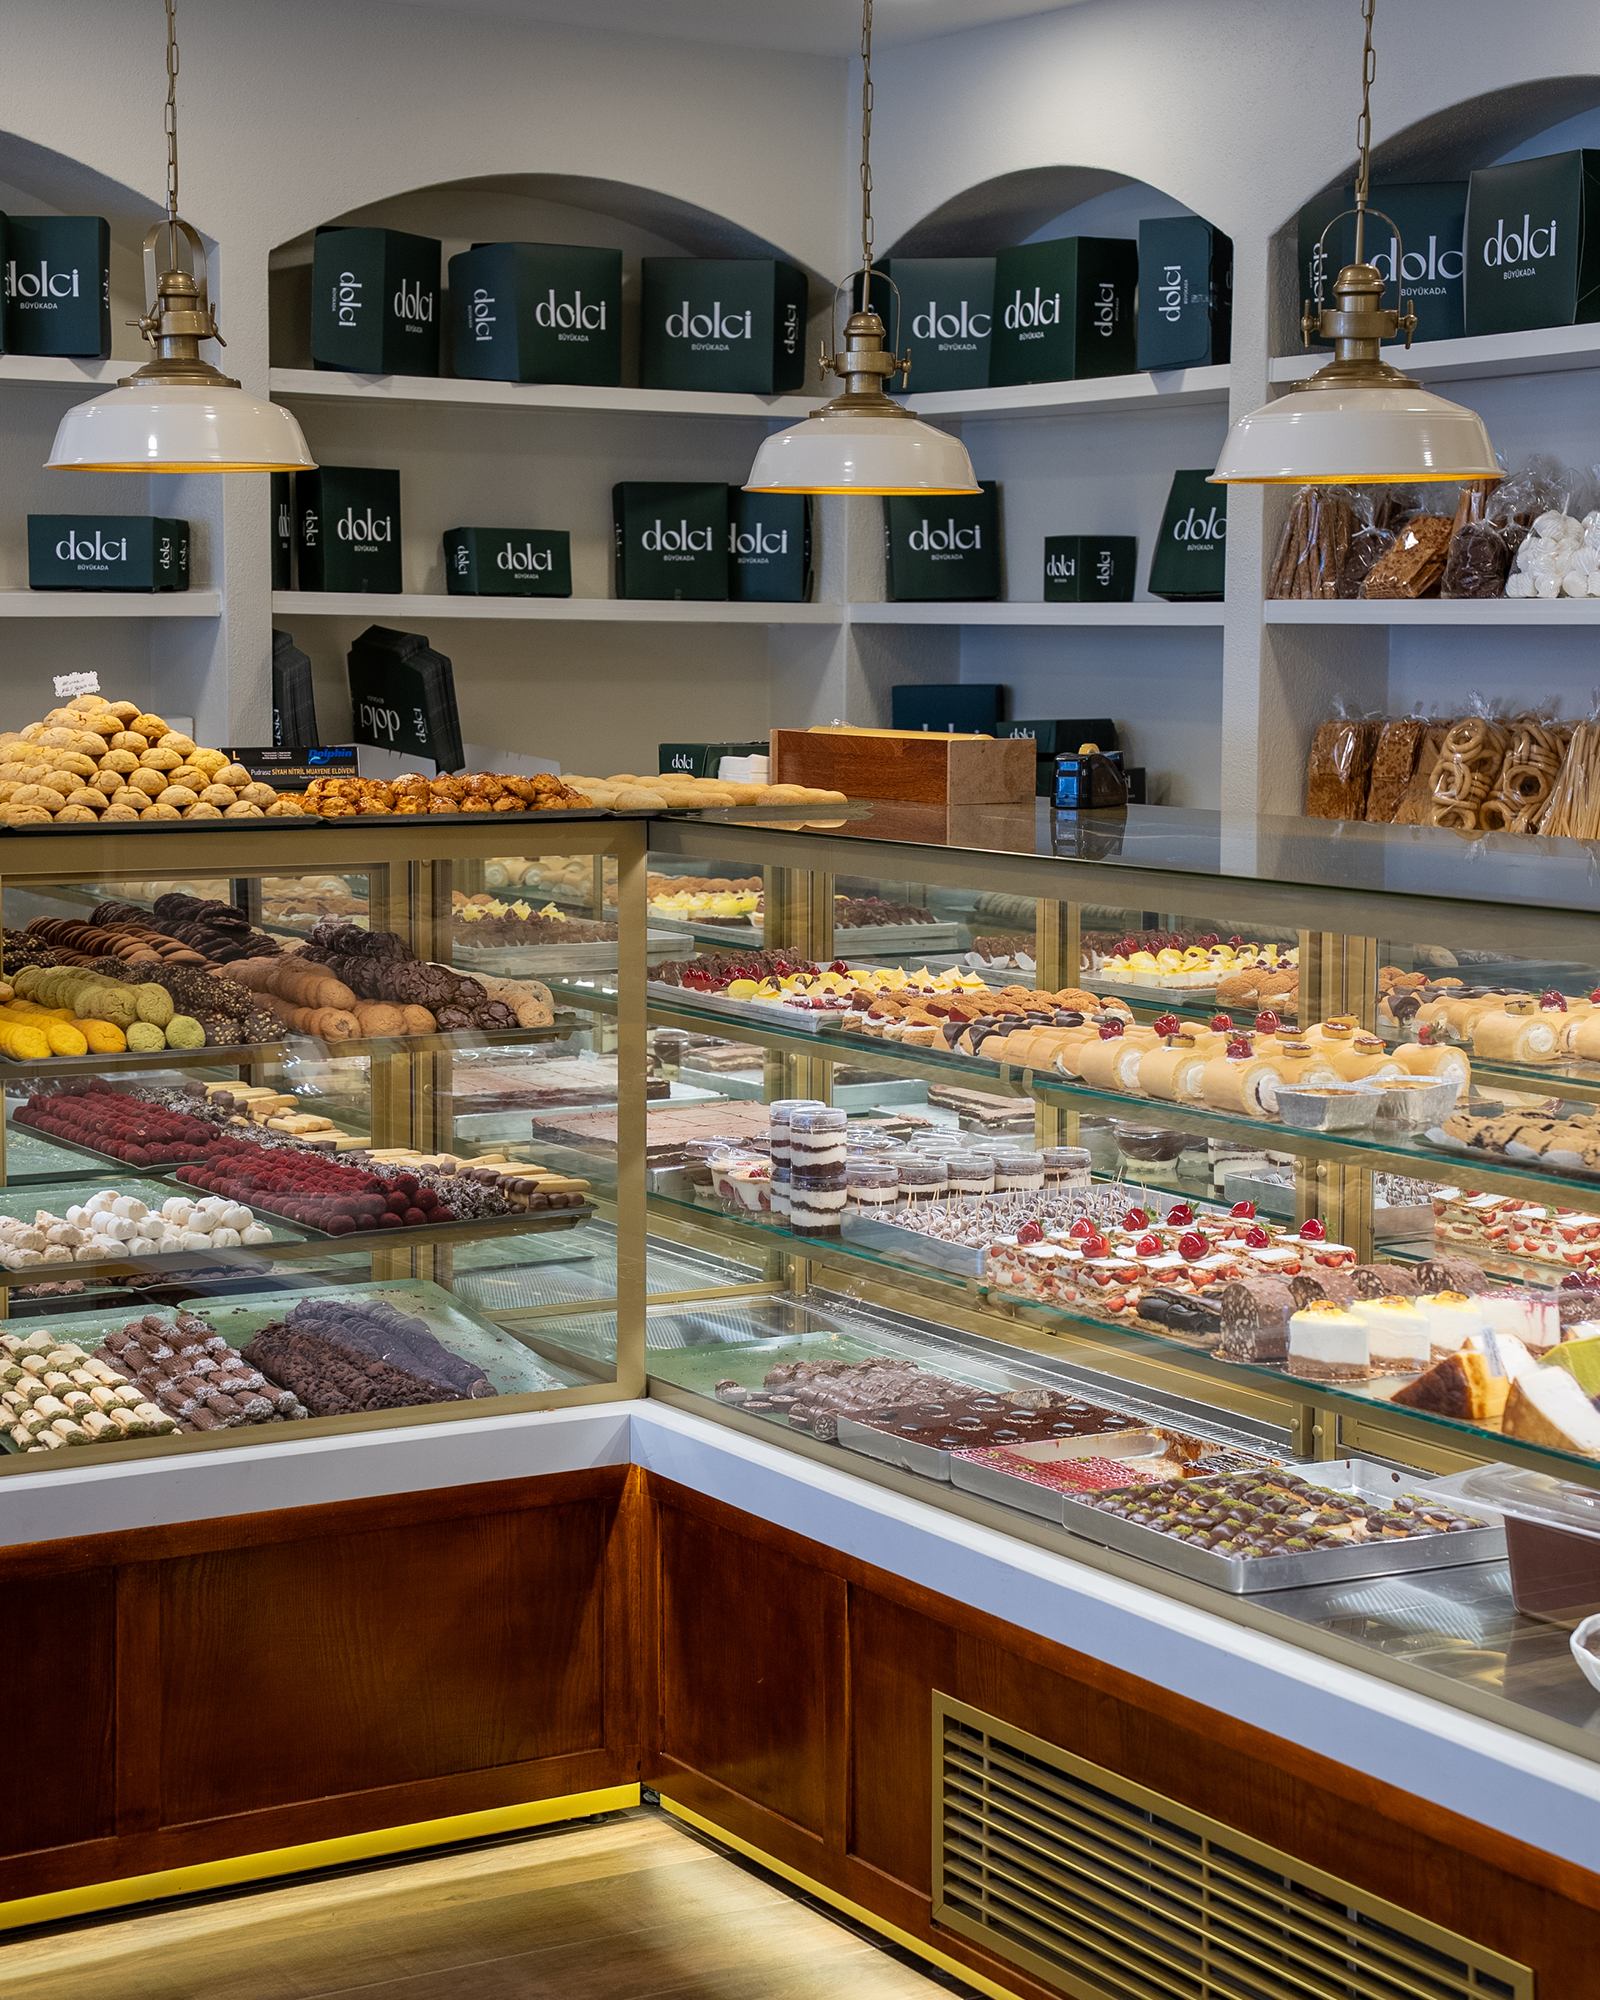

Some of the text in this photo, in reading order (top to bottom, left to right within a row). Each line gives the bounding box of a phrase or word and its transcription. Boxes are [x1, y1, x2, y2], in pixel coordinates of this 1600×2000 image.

[1483, 213, 1557, 267] dolci
[1503, 267, 1536, 280] BÜYÜKADA
[20, 302, 58, 310] BÜYÜKADA
[338, 271, 362, 327] dolci
[394, 278, 433, 322] dolci
[1004, 287, 1060, 329] dolci
[1158, 265, 1181, 322] dolci
[1400, 287, 1447, 297] BÜYÜKADA
[473, 288, 497, 341] dolci
[535, 289, 606, 330] dolci
[665, 301, 752, 339] dolci
[1094, 283, 1114, 337] dolci
[558, 333, 589, 342] BÜYÜKADA
[783, 304, 797, 354] dolci
[691, 343, 730, 351] BÜYÜKADA
[938, 343, 977, 351] BÜYÜKADA
[305, 509, 319, 546] dolci
[337, 507, 391, 542] dolci
[641, 519, 713, 551] dolci
[908, 518, 982, 551] dolci
[55, 530, 127, 561] dolci
[159, 537, 170, 569] dolci
[457, 545, 469, 575] dolci
[497, 542, 552, 571] dolci
[663, 554, 695, 562] BÜYÜKADA
[77, 563, 109, 571] BÜYÜKADA
[1046, 554, 1075, 576] dolci
[1096, 551, 1111, 586] dolci
[360, 703, 400, 741] dolci
[413, 707, 427, 743] dolci
[232, 750, 240, 761] L
[308, 748, 353, 760] Dolphin
[671, 753, 693, 770] dolci
